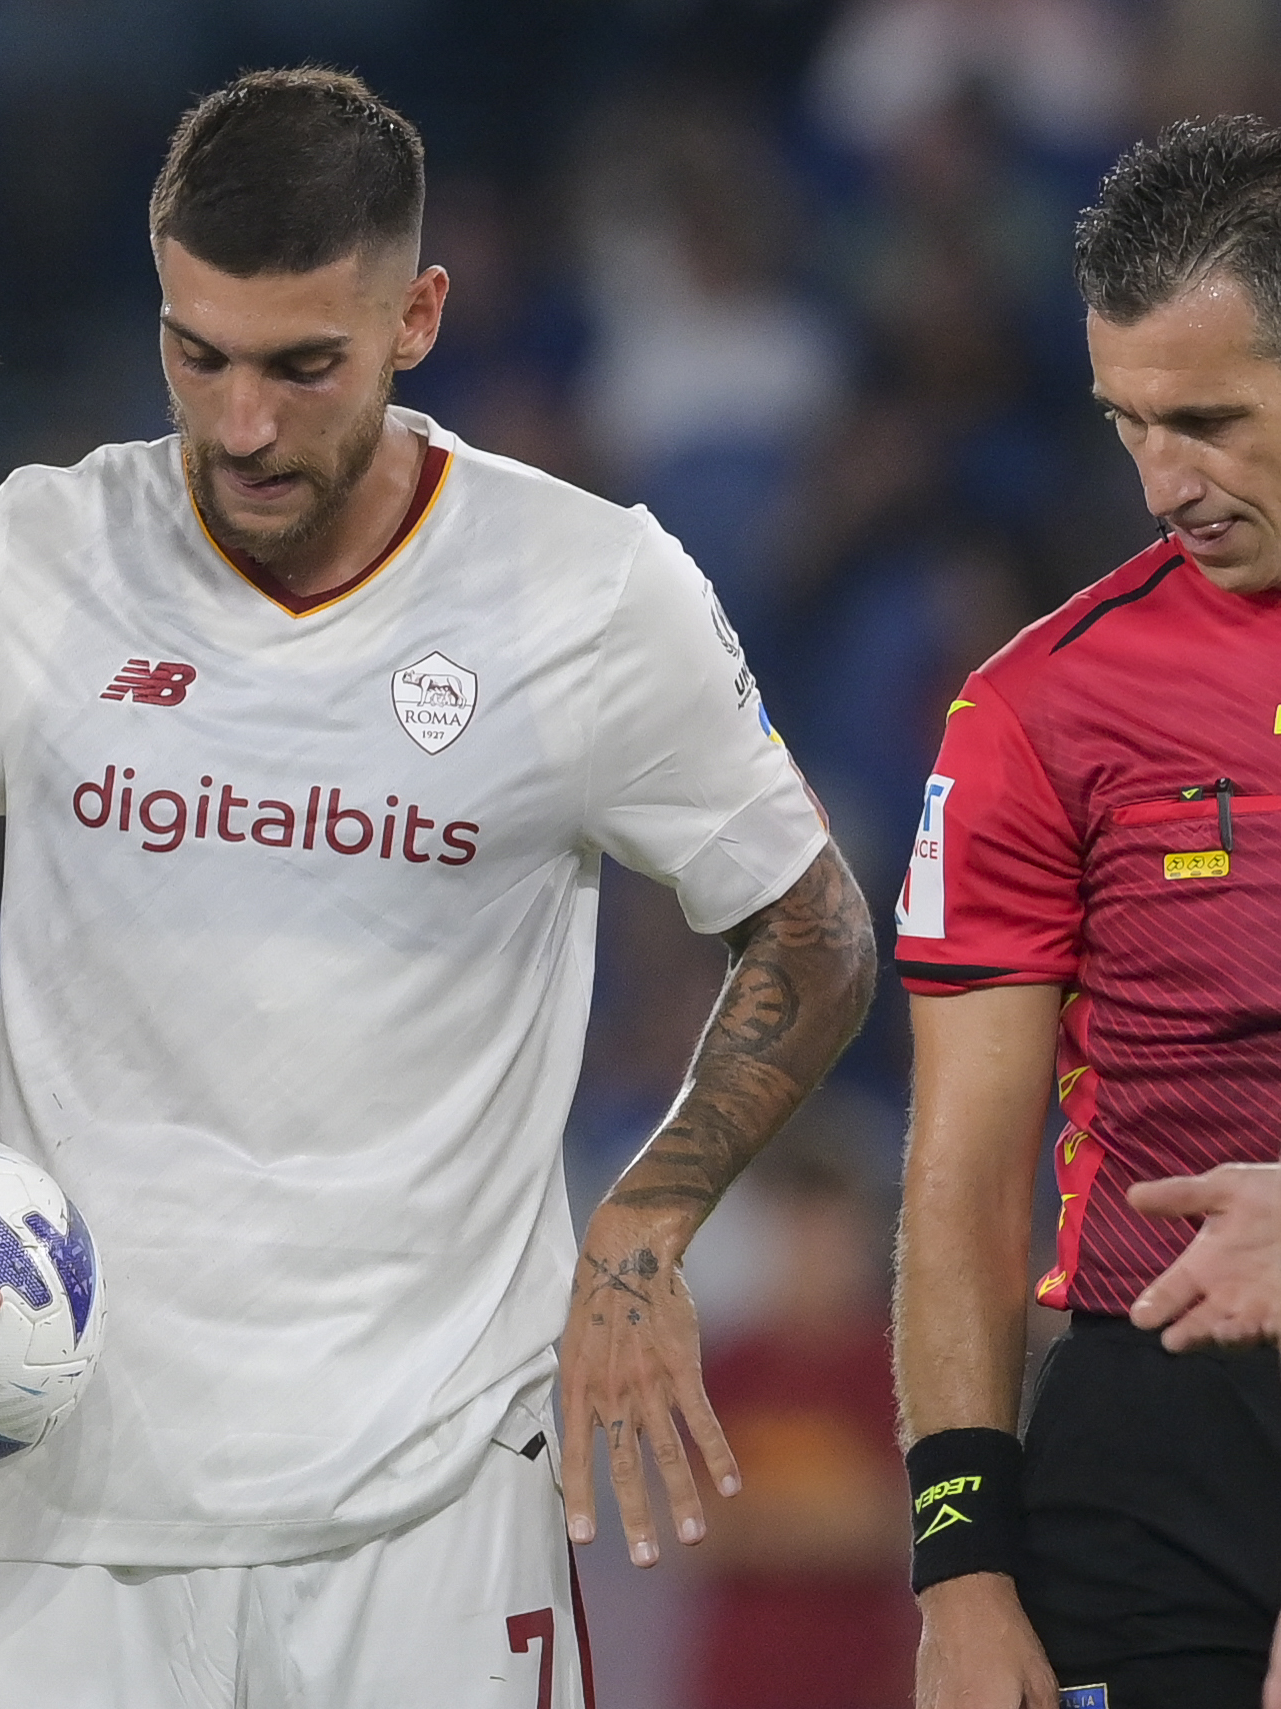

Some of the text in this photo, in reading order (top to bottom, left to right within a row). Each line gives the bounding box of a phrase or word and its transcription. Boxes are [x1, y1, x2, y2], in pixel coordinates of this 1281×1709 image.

[404, 709, 462, 727] ROMA
[422, 730, 445, 740] 1927
[72, 764, 480, 866] digitalbits
[914, 1475, 982, 1514] LEGEA
[505, 1606, 554, 1709] 7
